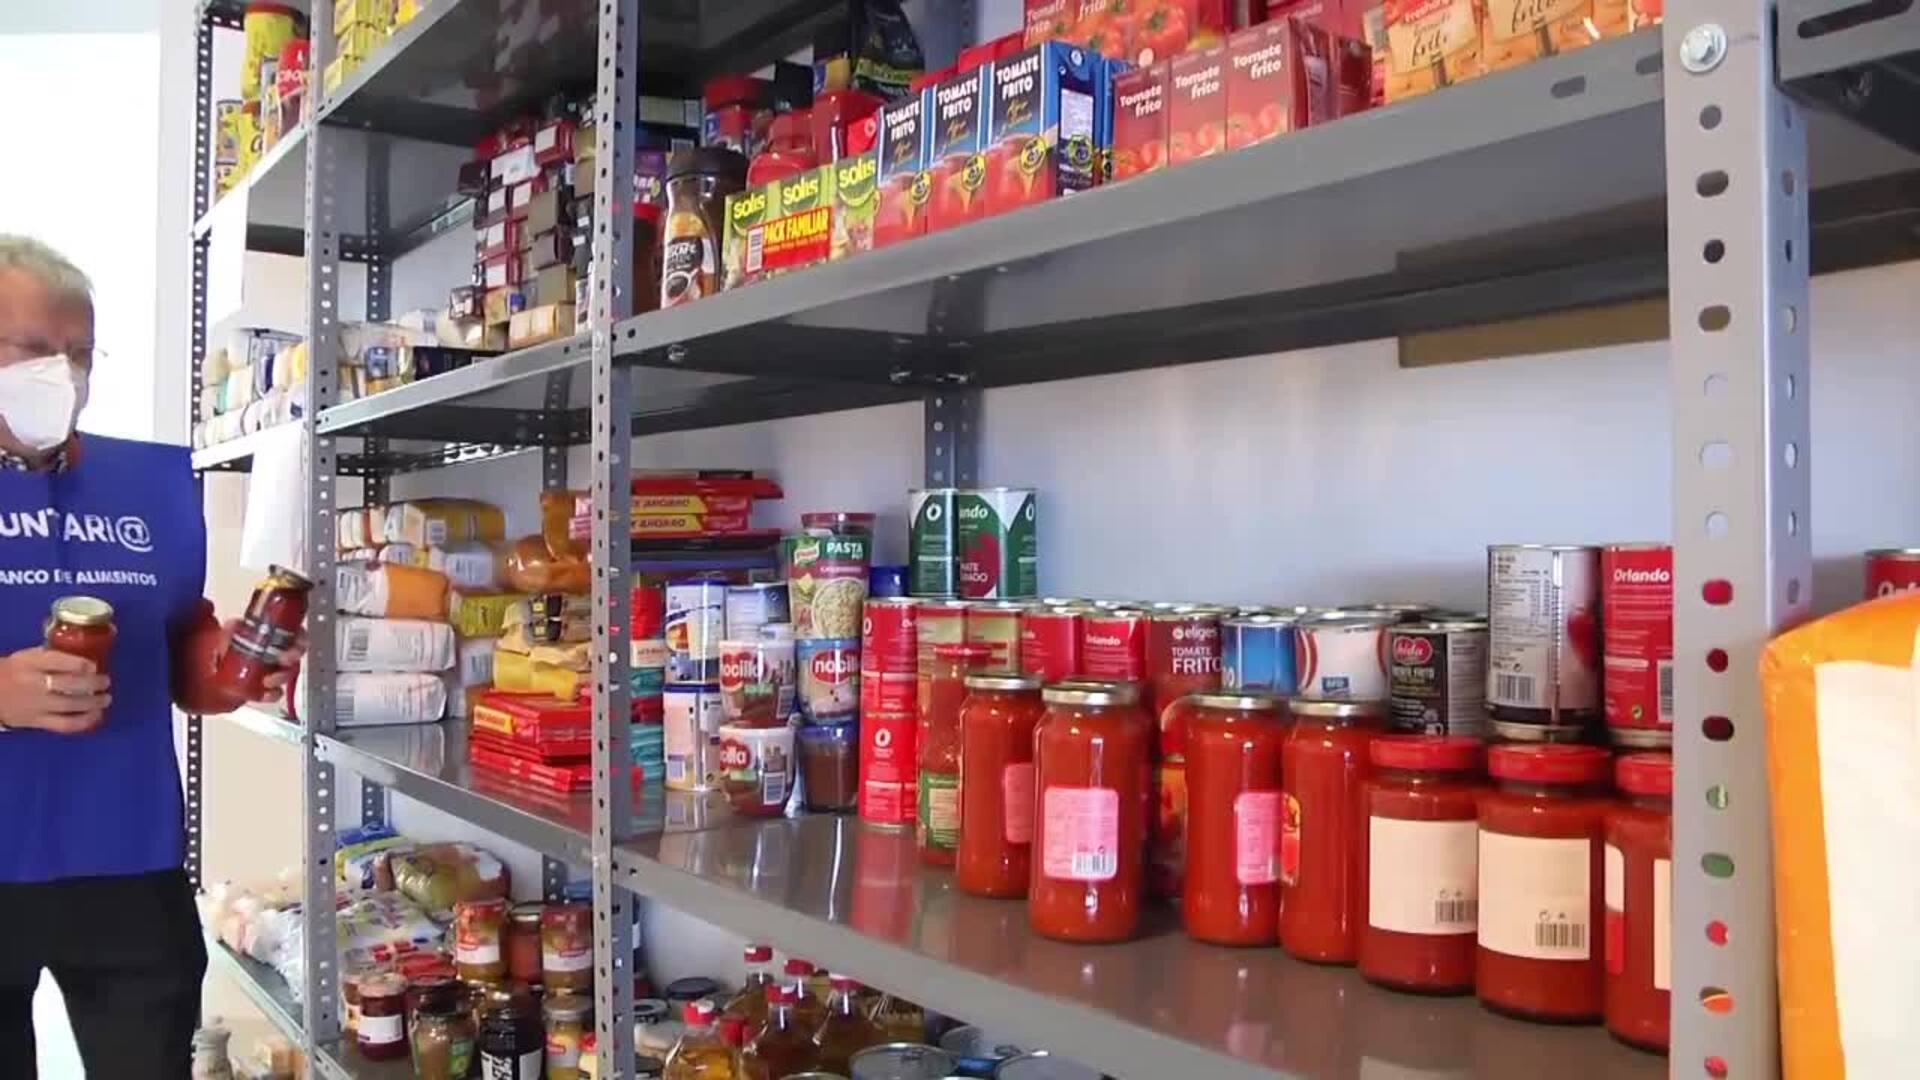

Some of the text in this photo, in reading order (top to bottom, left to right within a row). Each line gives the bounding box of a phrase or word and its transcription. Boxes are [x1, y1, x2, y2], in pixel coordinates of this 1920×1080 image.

[1231, 43, 1283, 70] Tomate
[995, 54, 1040, 86] TOMATE
[1175, 64, 1221, 91] Tomate
[1249, 58, 1283, 81] frito
[936, 77, 978, 106] TOMATE
[1001, 77, 1034, 101] FRITO
[1119, 83, 1164, 108] Tomate
[1190, 79, 1221, 100] frito
[884, 100, 921, 129] TOMATE
[941, 97, 973, 121] FRITO
[1134, 99, 1163, 118] frito
[889, 117, 916, 142] FRITO
[763, 206, 830, 243] PACK FAMILIAR
[826, 541, 863, 553] PASTA
[54, 569, 72, 584] DE
[76, 570, 157, 586] ALIMENTOS
[1613, 568, 1670, 583] Orlando
[1184, 626, 1217, 642] eliges
[1171, 646, 1211, 658] TOMATE
[1171, 656, 1223, 675] FRITO
